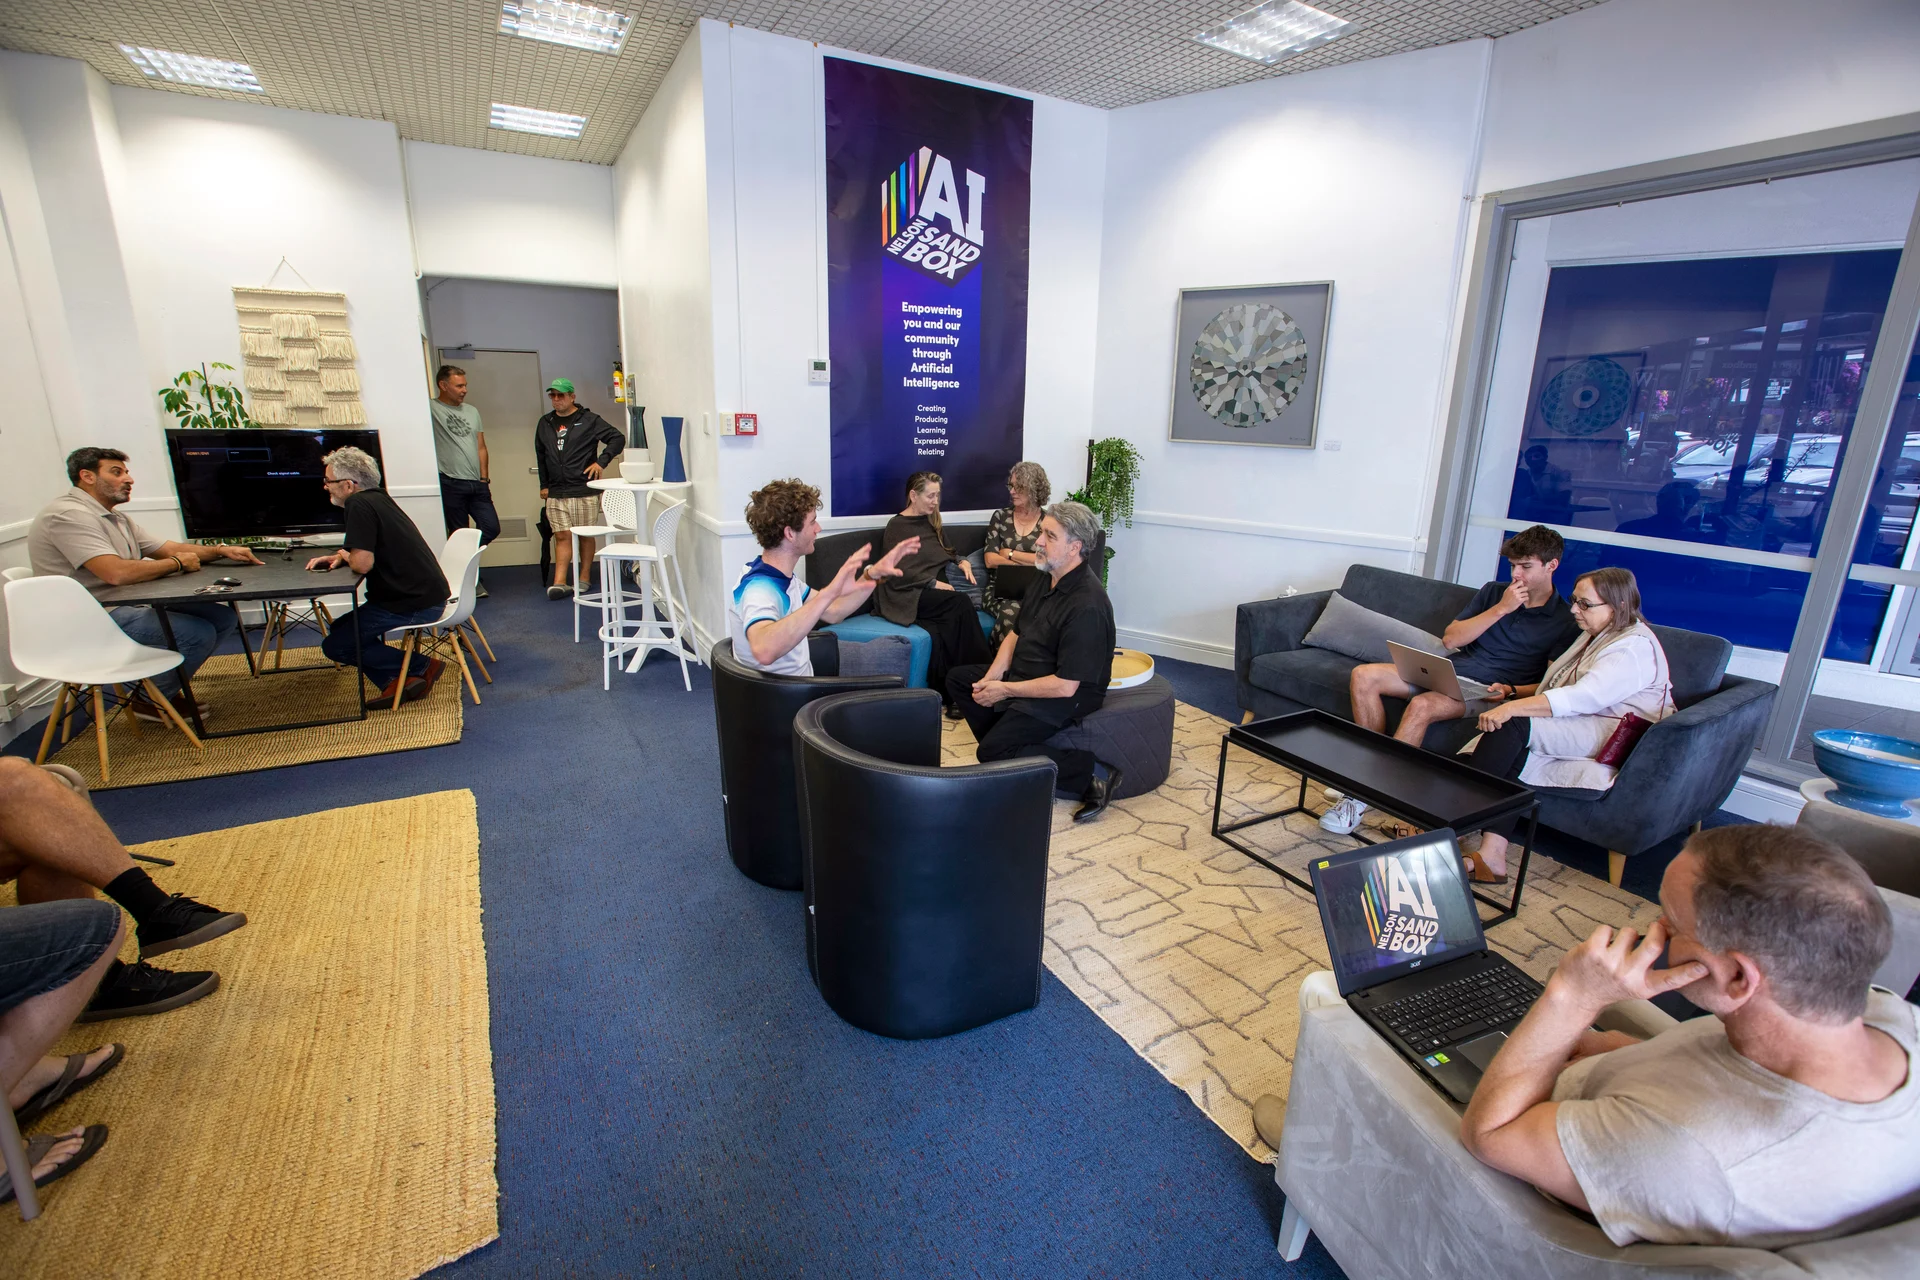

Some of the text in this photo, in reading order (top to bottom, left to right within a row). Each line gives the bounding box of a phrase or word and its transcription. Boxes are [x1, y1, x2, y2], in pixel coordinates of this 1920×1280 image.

[918, 153, 986, 247] AI
[886, 218, 928, 255] NELSON
[918, 226, 981, 262] SAND
[901, 241, 968, 280] BOX
[901, 301, 963, 318] Empowering
[903, 318, 961, 331] you and our
[904, 333, 960, 347] community
[912, 348, 952, 361] through
[910, 362, 953, 374] Artificial
[903, 377, 960, 390] Intelligence
[917, 404, 946, 413] Creating
[914, 415, 948, 424] Producing
[916, 426, 946, 435] Learning
[913, 437, 949, 446] Expressing
[917, 448, 945, 457] Relating
[1387, 856, 1439, 919] AI
[1377, 913, 1398, 949] NELSON
[1394, 916, 1439, 937] SAND
[1388, 932, 1433, 956] BOX
